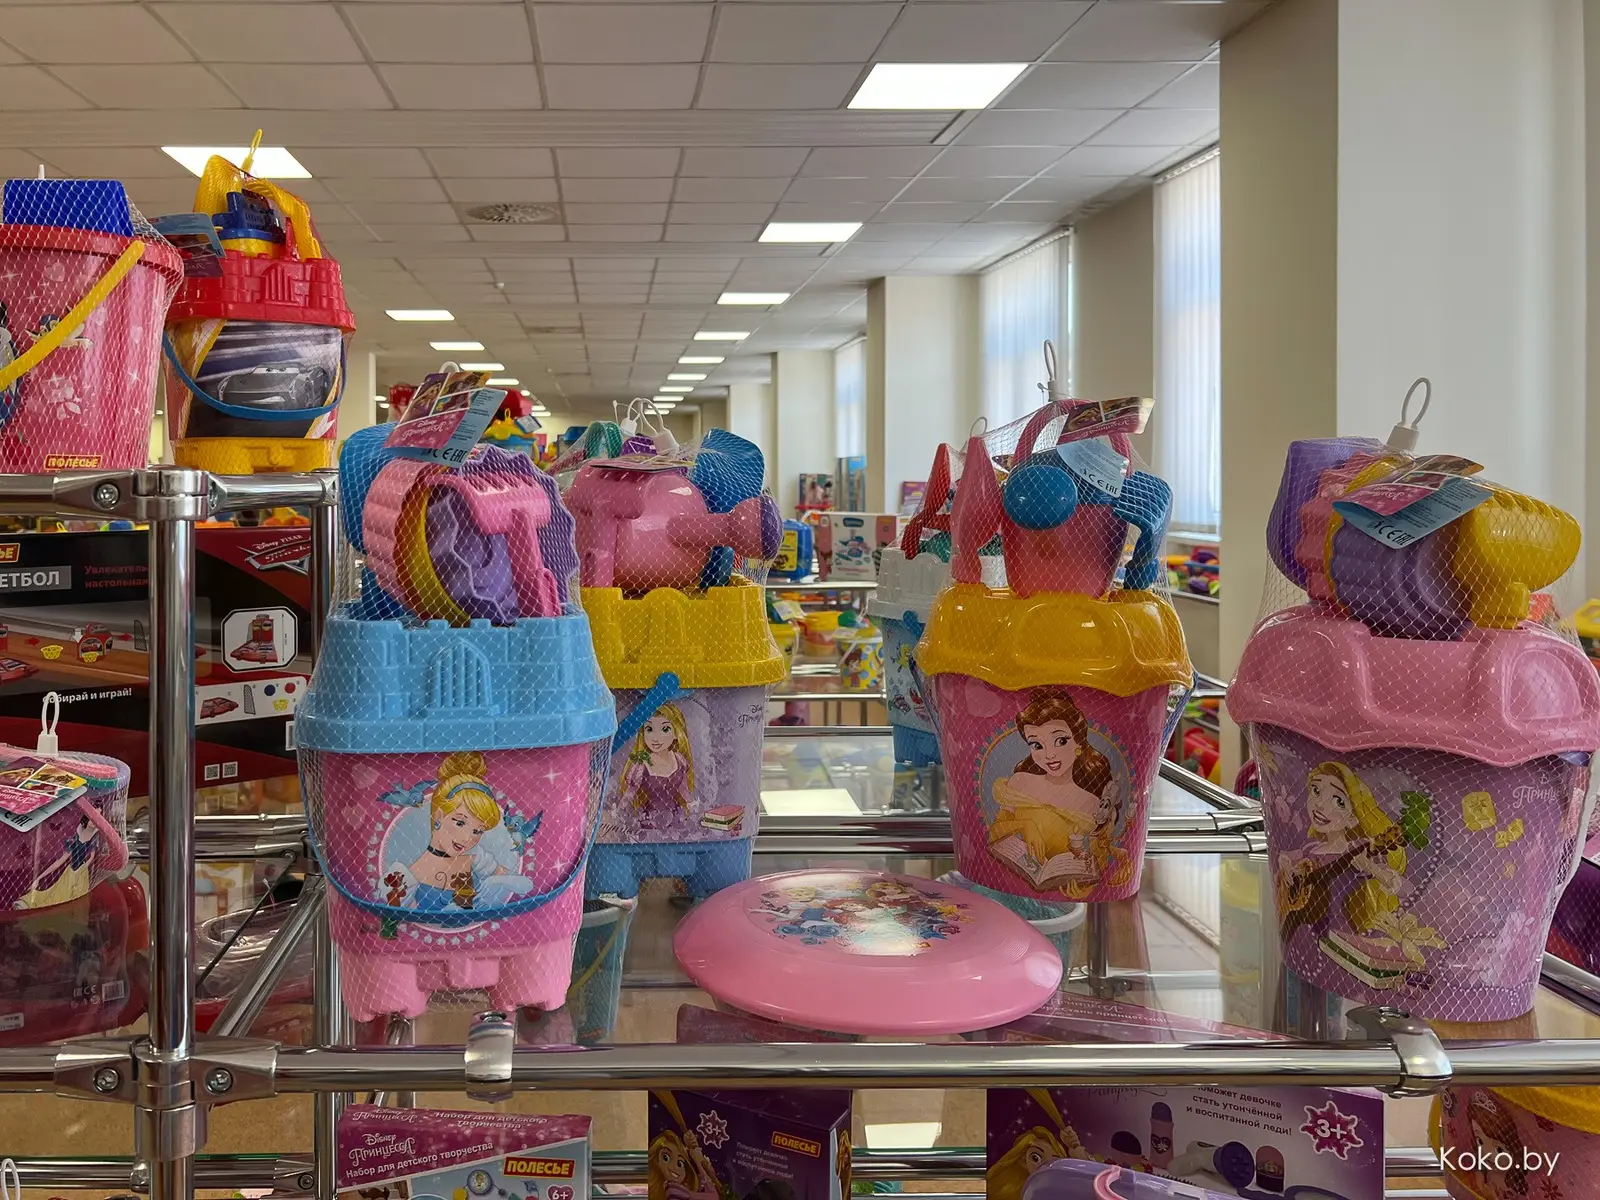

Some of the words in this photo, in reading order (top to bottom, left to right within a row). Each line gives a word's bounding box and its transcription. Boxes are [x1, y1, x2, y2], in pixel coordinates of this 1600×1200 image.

[48, 456, 99, 467] ПОЛЕСЬЕ
[90, 692, 97, 700] и
[99, 687, 132, 700] играй!
[1192, 1094, 1220, 1106] стать
[1222, 1101, 1283, 1121] утончённой
[1239, 1093, 1282, 1108] девочке
[1185, 1105, 1192, 1113] и
[1195, 1107, 1260, 1128] воспитанной
[1263, 1123, 1292, 1136] леди!
[705, 1121, 722, 1136] 3+
[1315, 1119, 1347, 1139] 3+
[362, 1132, 397, 1146] Disney
[773, 1135, 818, 1154] ПОЛЕСЬЕ
[346, 1167, 376, 1179] Набор
[377, 1162, 395, 1174] для
[397, 1153, 438, 1169] детского
[440, 1141, 494, 1159] творчества
[507, 1160, 570, 1175] ПОЛЕСЬЕ
[552, 1189, 569, 1200] 6+
